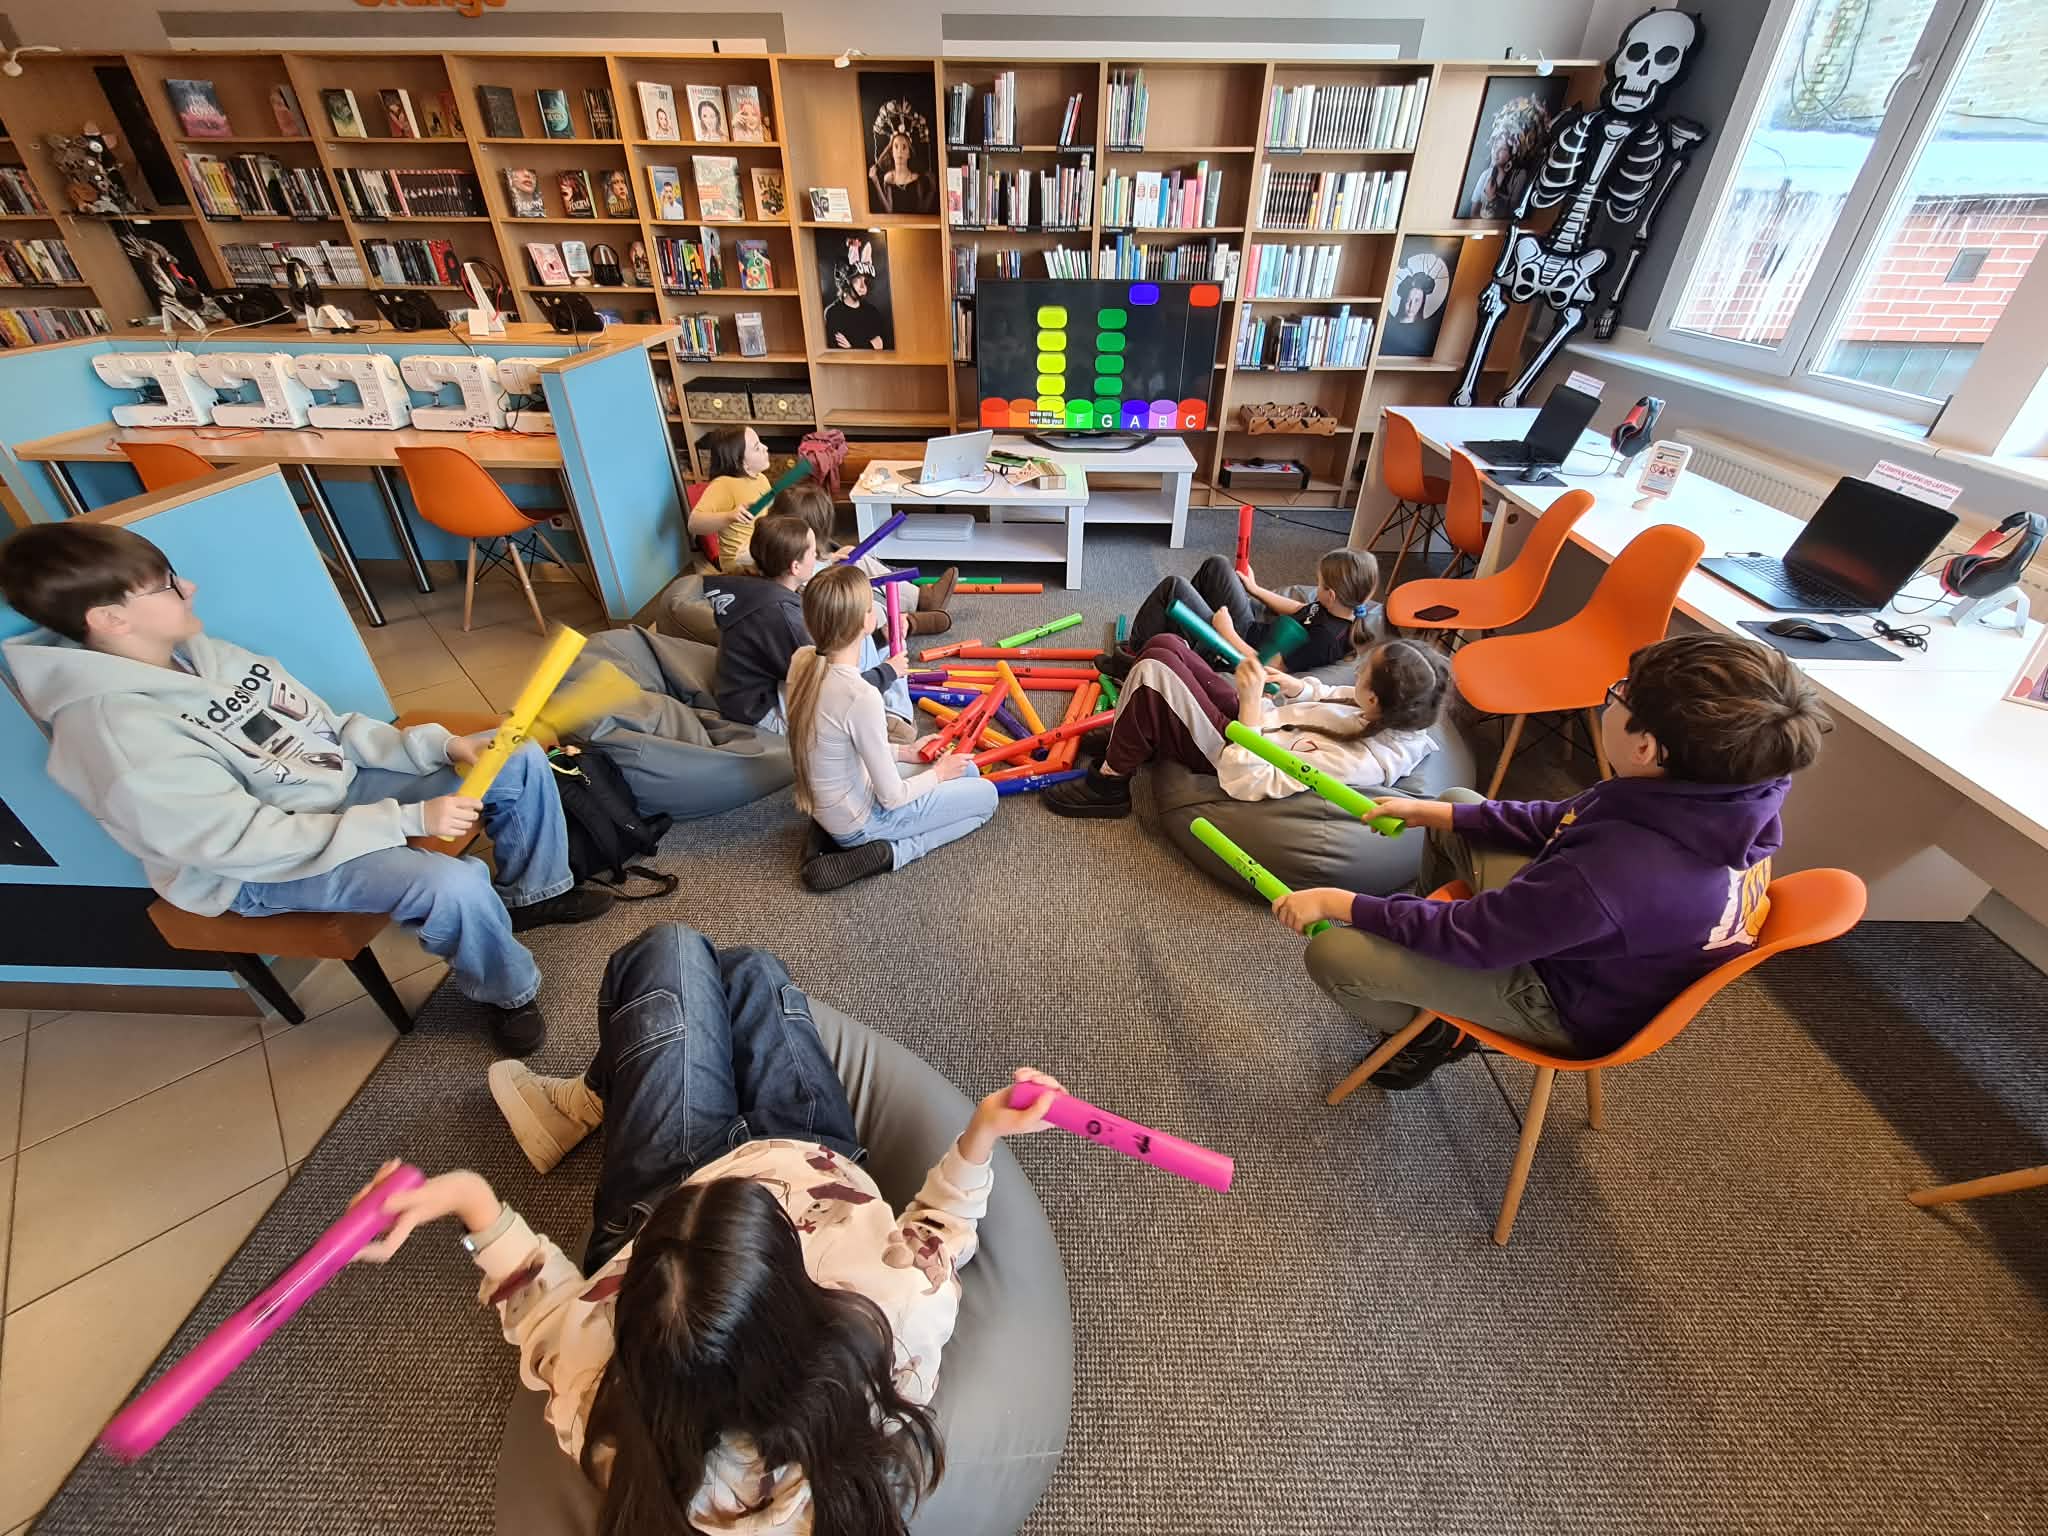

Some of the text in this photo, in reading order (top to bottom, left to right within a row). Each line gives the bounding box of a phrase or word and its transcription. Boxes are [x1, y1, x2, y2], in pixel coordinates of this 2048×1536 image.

[757, 175, 782, 190] HAJ
[1076, 415, 1084, 427] F
[1101, 414, 1113, 428] G
[1129, 415, 1141, 428] A
[1159, 415, 1168, 427] B
[1185, 415, 1196, 428] C
